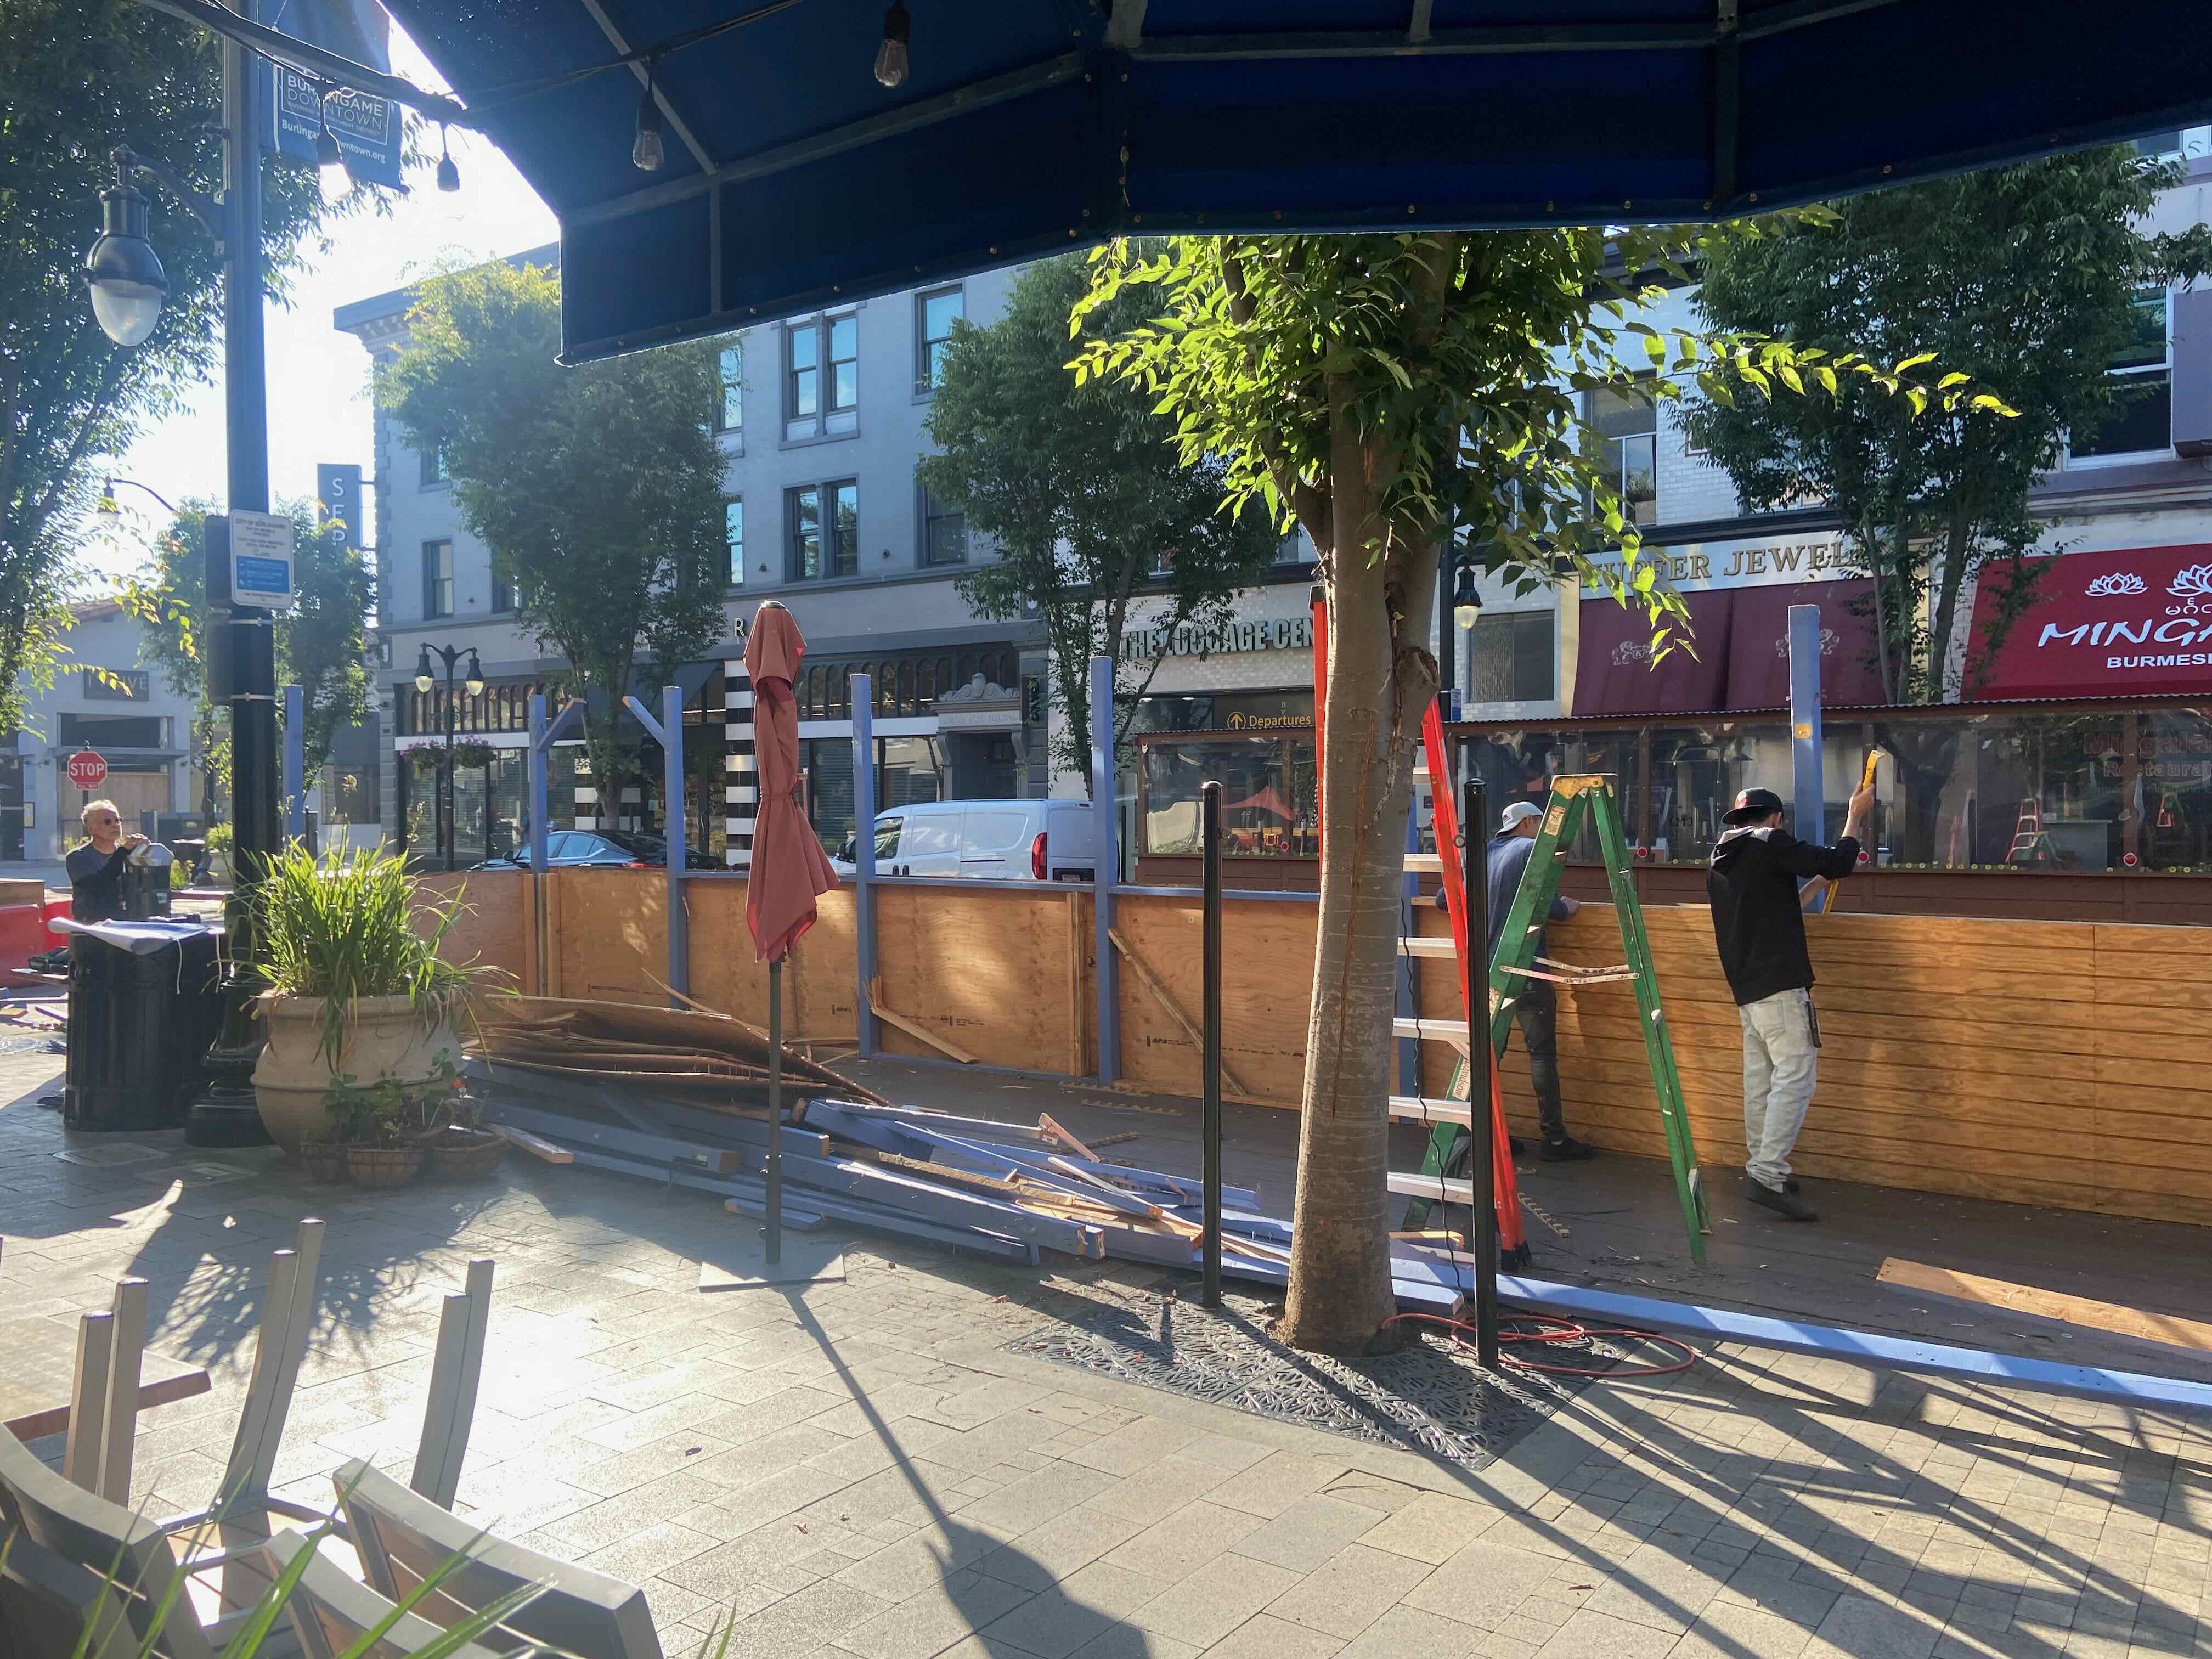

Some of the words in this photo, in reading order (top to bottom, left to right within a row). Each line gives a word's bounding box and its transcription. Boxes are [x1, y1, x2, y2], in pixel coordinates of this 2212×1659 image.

[287, 75, 383, 117] BURNGAME
[281, 119, 386, 164] Burlingawntown.org
[1249, 715, 1311, 729] Departures
[70, 763, 104, 776] STOP
